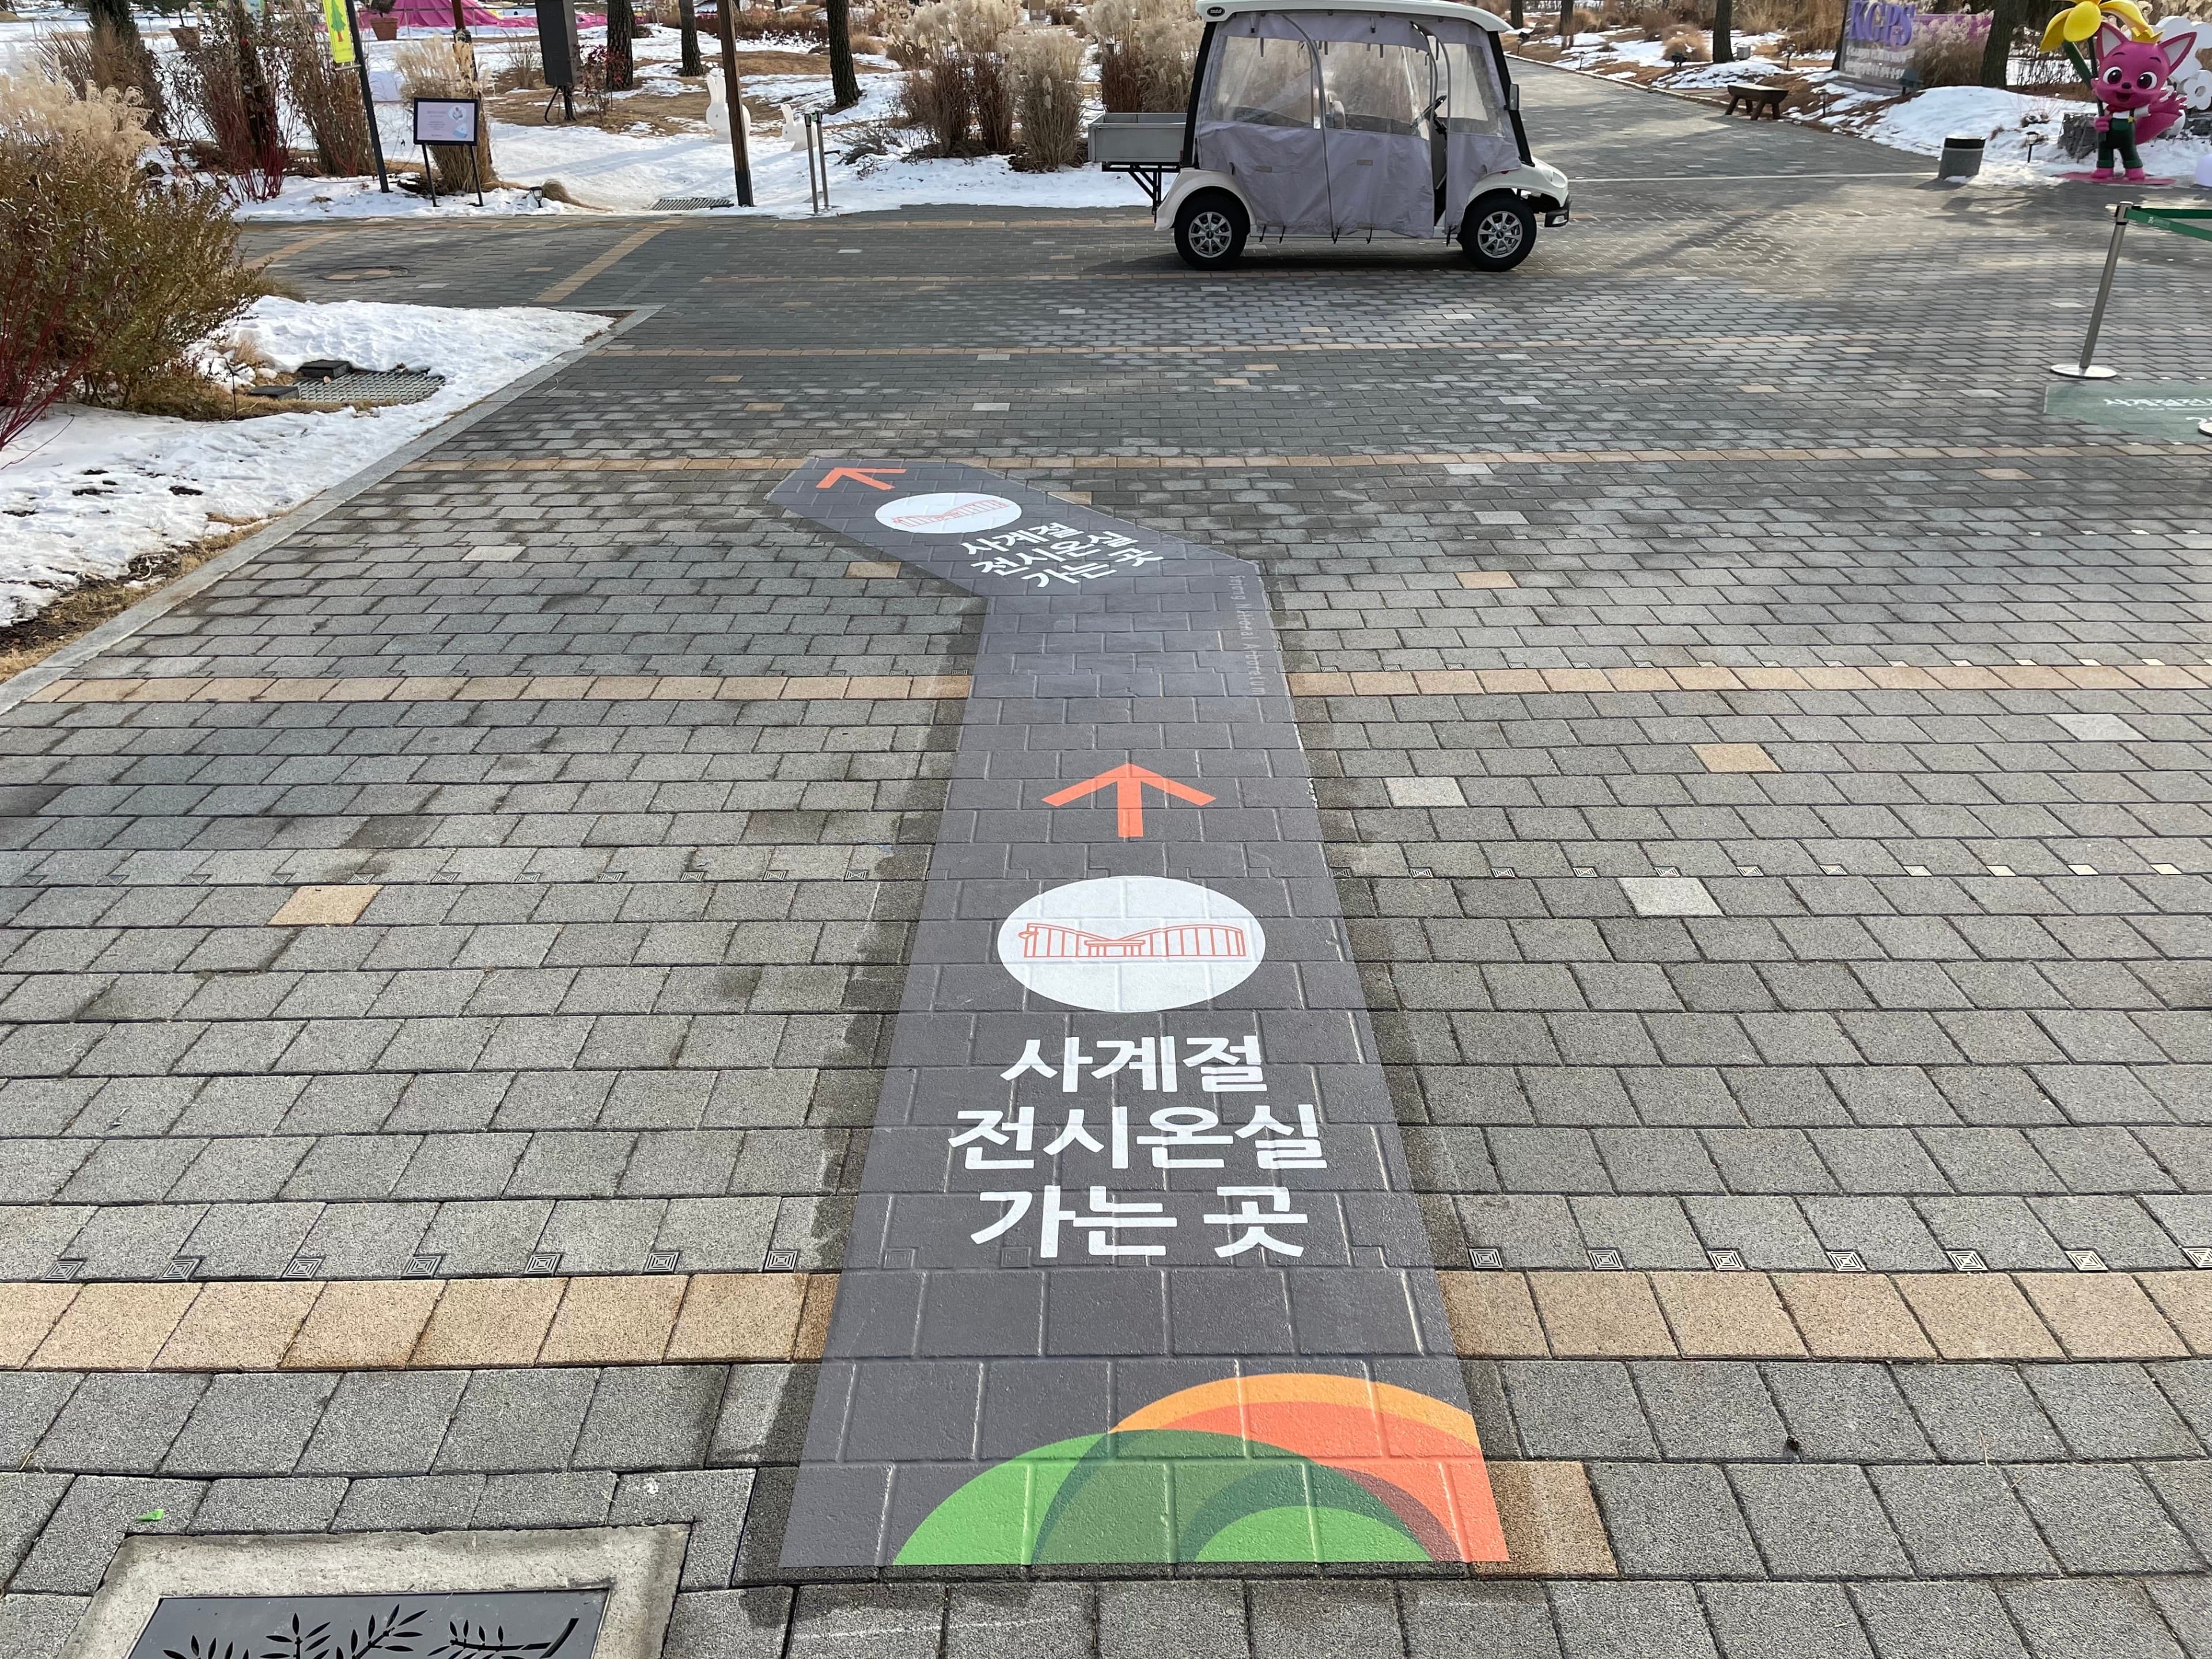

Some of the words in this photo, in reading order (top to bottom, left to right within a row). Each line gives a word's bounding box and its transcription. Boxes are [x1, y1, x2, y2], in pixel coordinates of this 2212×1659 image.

[960, 522, 1085, 555] 사계절
[971, 531, 1139, 576] 전시온실
[1021, 562, 1118, 588] 가는
[1107, 548, 1164, 567] 곳
[1000, 1035, 1268, 1093] 사계절
[948, 1104, 1328, 1169] 전시온실
[970, 1185, 1177, 1258] 가는
[1203, 1186, 1308, 1258] 곳
